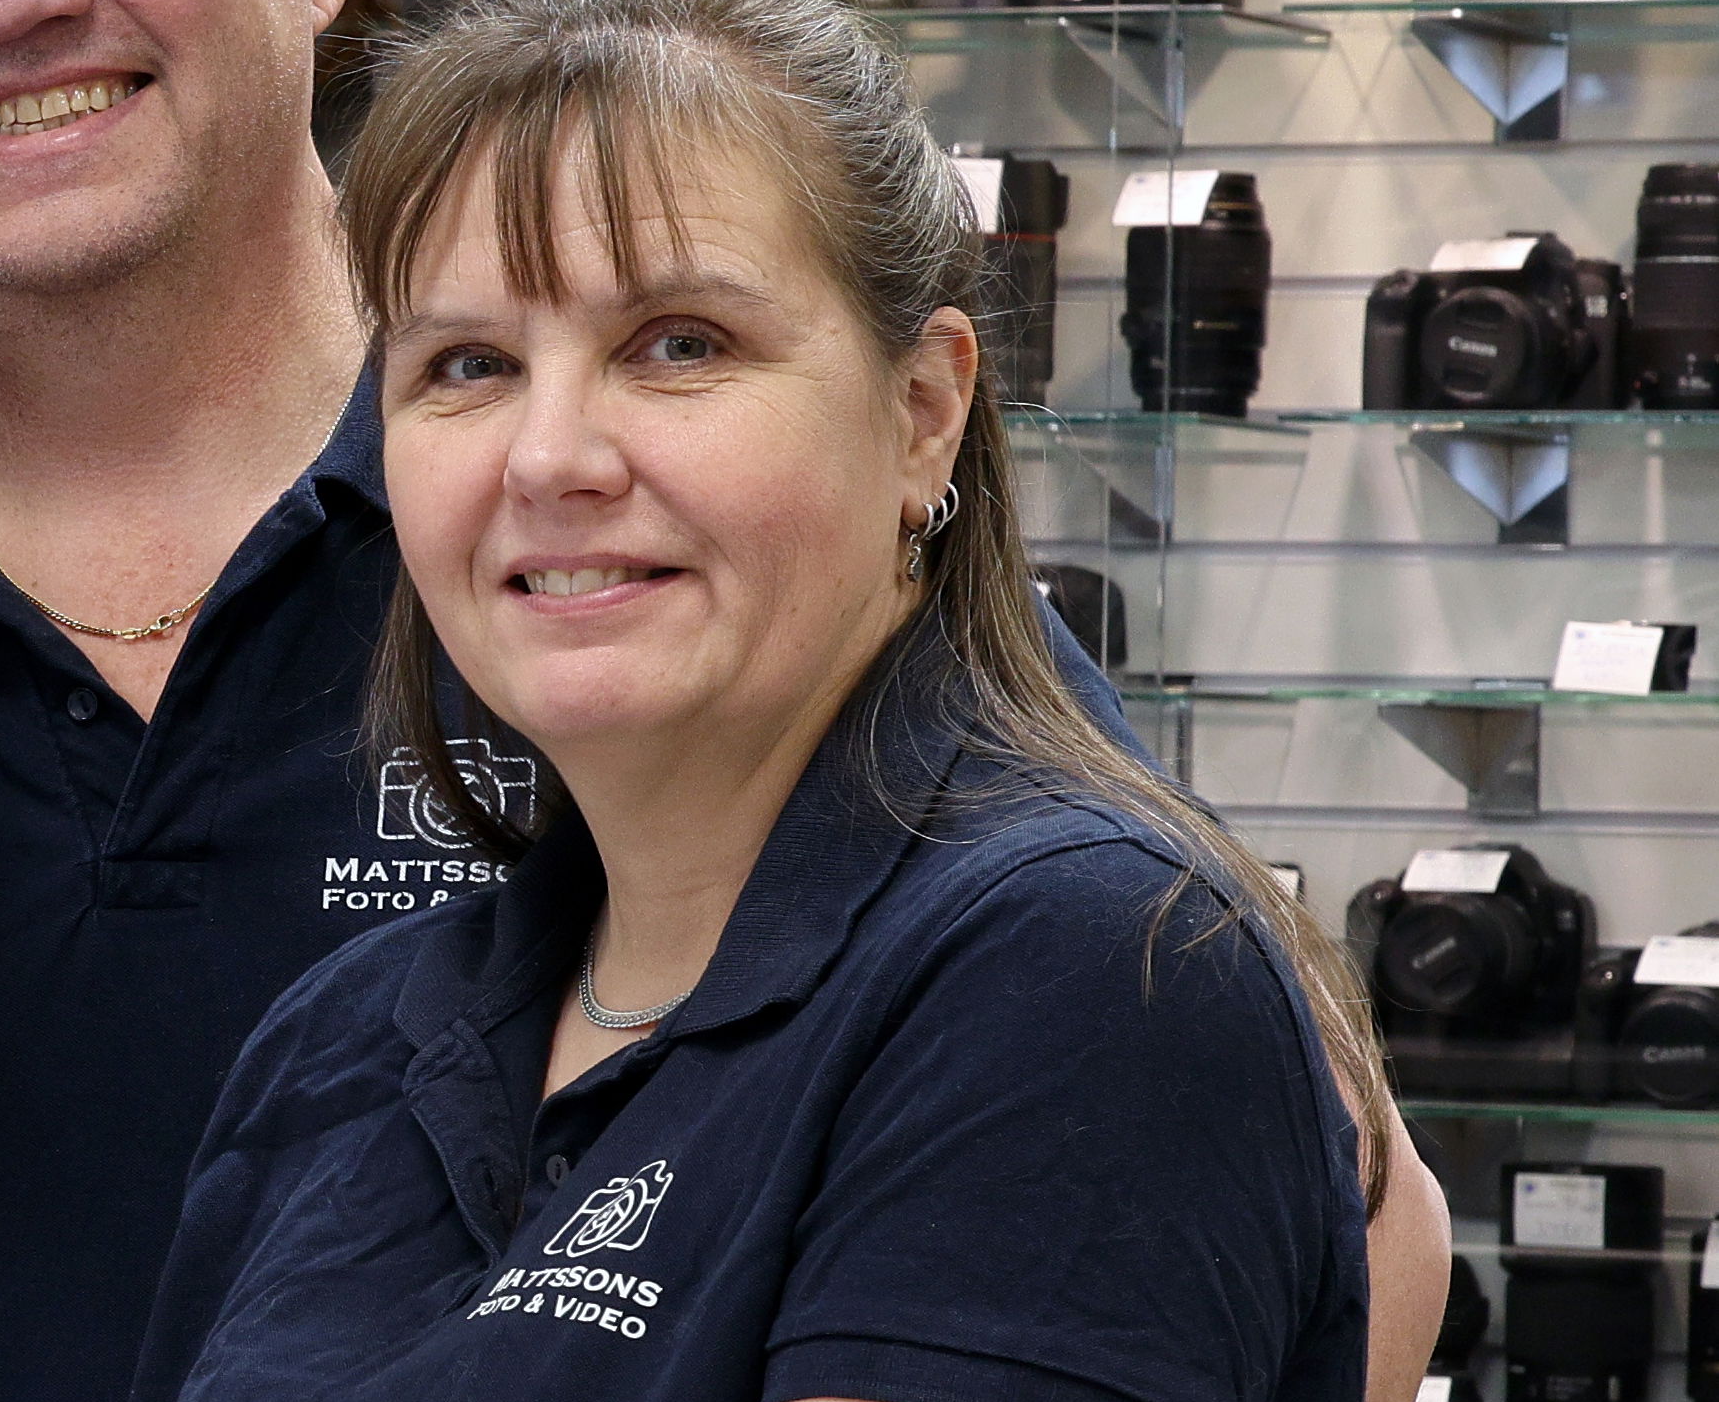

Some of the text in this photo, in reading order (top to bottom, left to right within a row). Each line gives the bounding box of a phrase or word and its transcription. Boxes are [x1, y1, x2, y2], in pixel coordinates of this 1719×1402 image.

[324, 857, 509, 883] MATTSSO
[322, 888, 416, 911] FOTO
[487, 1265, 664, 1308] MATTSSONS
[466, 1293, 647, 1340] FOTO & VIDEO
